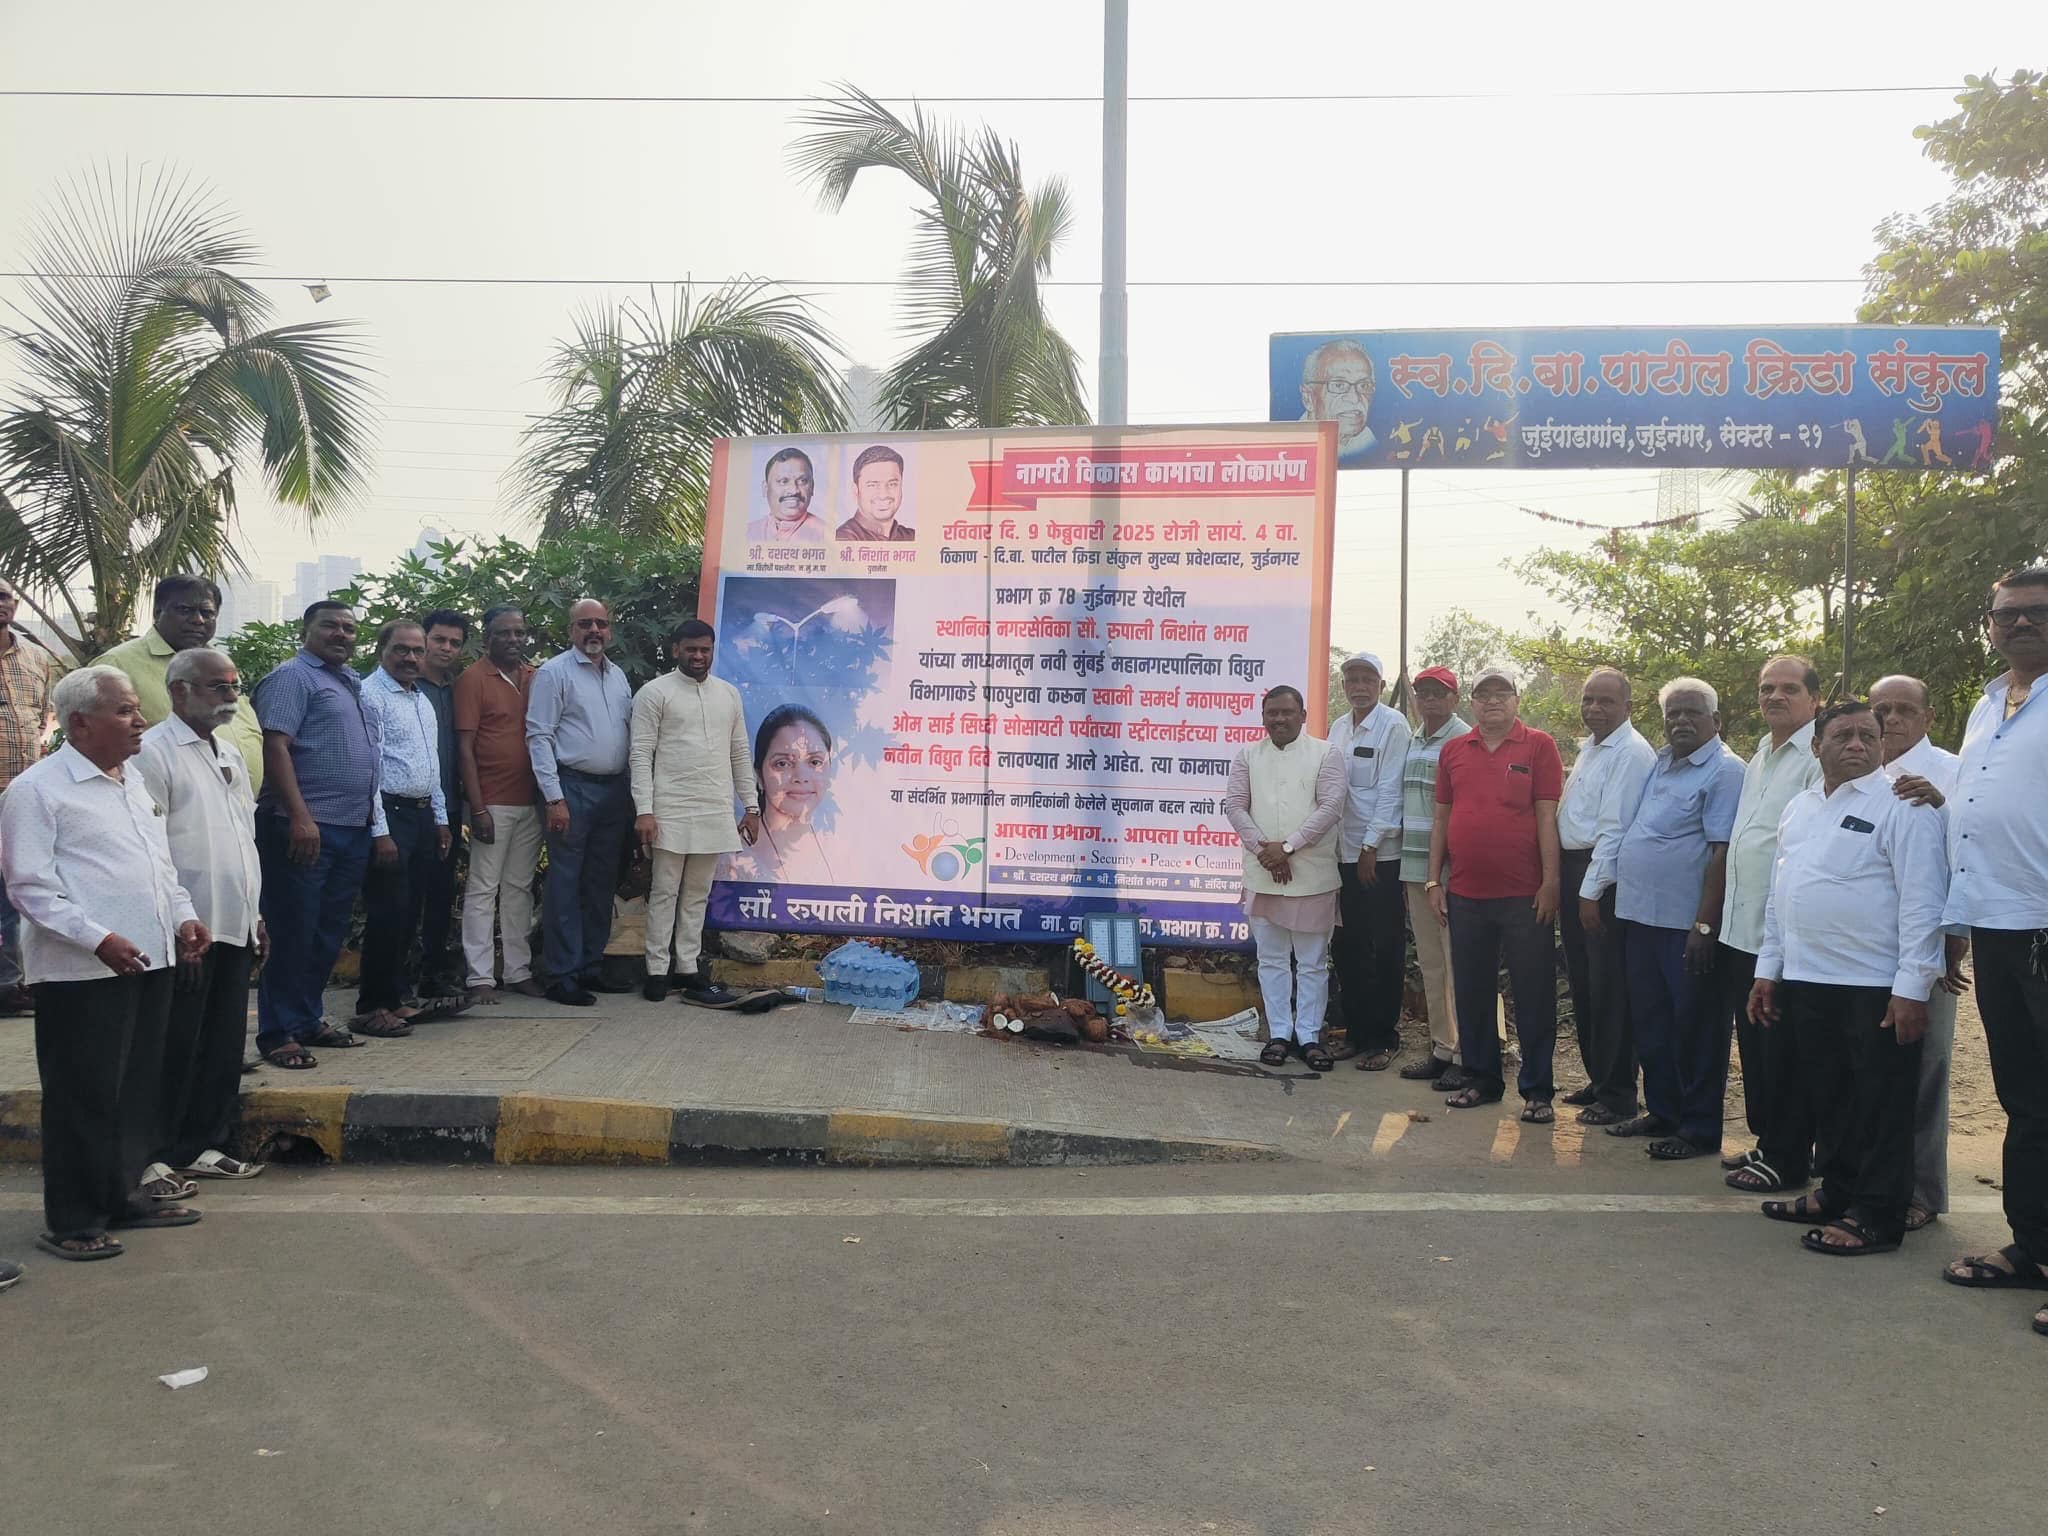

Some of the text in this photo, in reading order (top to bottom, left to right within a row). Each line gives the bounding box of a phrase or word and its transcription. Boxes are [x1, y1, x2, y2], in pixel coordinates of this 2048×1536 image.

[1744, 338, 1855, 398] क्रिडा
[1867, 335, 1990, 412] संकुल
[1720, 417, 1773, 448] सेक्टर
[1798, 423, 1823, 449] २१
[1016, 451, 1307, 484] नागरी विकास कामांचा लोकार्पण
[943, 520, 993, 541] रविवार
[1000, 520, 1019, 540] दि.
[1028, 524, 1039, 540] 9
[1112, 525, 1155, 542] 2025
[1163, 520, 1201, 542] रोजी
[1207, 521, 1246, 542] सायं.
[1255, 524, 1268, 542] 4
[1274, 524, 1297, 542] वा.
[749, 545, 826, 561] श्री. दशरथ भगत
[840, 546, 916, 562] श्री. निशांत भगत
[940, 547, 978, 564] ठिकाण
[1031, 546, 1067, 564] पाटील
[1072, 546, 1101, 565] क्रिडा
[1106, 548, 1142, 569] संकुल
[1147, 551, 1180, 569] मुख्य
[1250, 548, 1300, 570] जुईनगर
[995, 585, 1187, 612] प्रभाग क्र 78 जुईनगर येथील
[936, 615, 1249, 643] स्थानिक नगरसेविका सौ. रुपाली निशांत भगत
[919, 648, 1265, 682] यांच्या माध्यमातून नवी मुंबई महानगरपालिका विद्युत
[909, 679, 977, 702] विभागाकडे
[982, 685, 1042, 708] पाठपुरावा
[1047, 687, 1087, 705] करून
[1092, 684, 1134, 706] स्वामी
[1139, 686, 1180, 708] समर्थ
[892, 711, 922, 733] ओम
[928, 712, 955, 735] साई
[1003, 714, 1064, 736] सोसायटी
[1068, 714, 1122, 739] पर्यंतच्या
[883, 743, 1231, 777] नवीन विद्युत दिवे लावण्यात आले आहेत. त्या कामाचा
[890, 789, 903, 803] या
[951, 790, 1005, 807] प्रभागातील
[1010, 791, 1070, 809] नागरिकांनी
[1074, 793, 1107, 811] केलेले
[1158, 800, 1185, 814] बद्दल
[1189, 798, 1215, 815] त्यांचे
[994, 823, 1048, 840] आपला
[1124, 827, 1179, 844] आपला
[1004, 846, 1243, 870] Development Security Peace Cleanlin
[1060, 874, 1082, 884] भगत
[1146, 878, 1168, 888] भगत
[739, 889, 776, 919] सौ.
[786, 894, 868, 923] रुपाली
[874, 894, 953, 928] निशांत
[959, 903, 1023, 931] भगत
[1040, 914, 1064, 933] मा.
[1159, 918, 1203, 938] प्रभाग
[1229, 922, 1250, 941] 78
